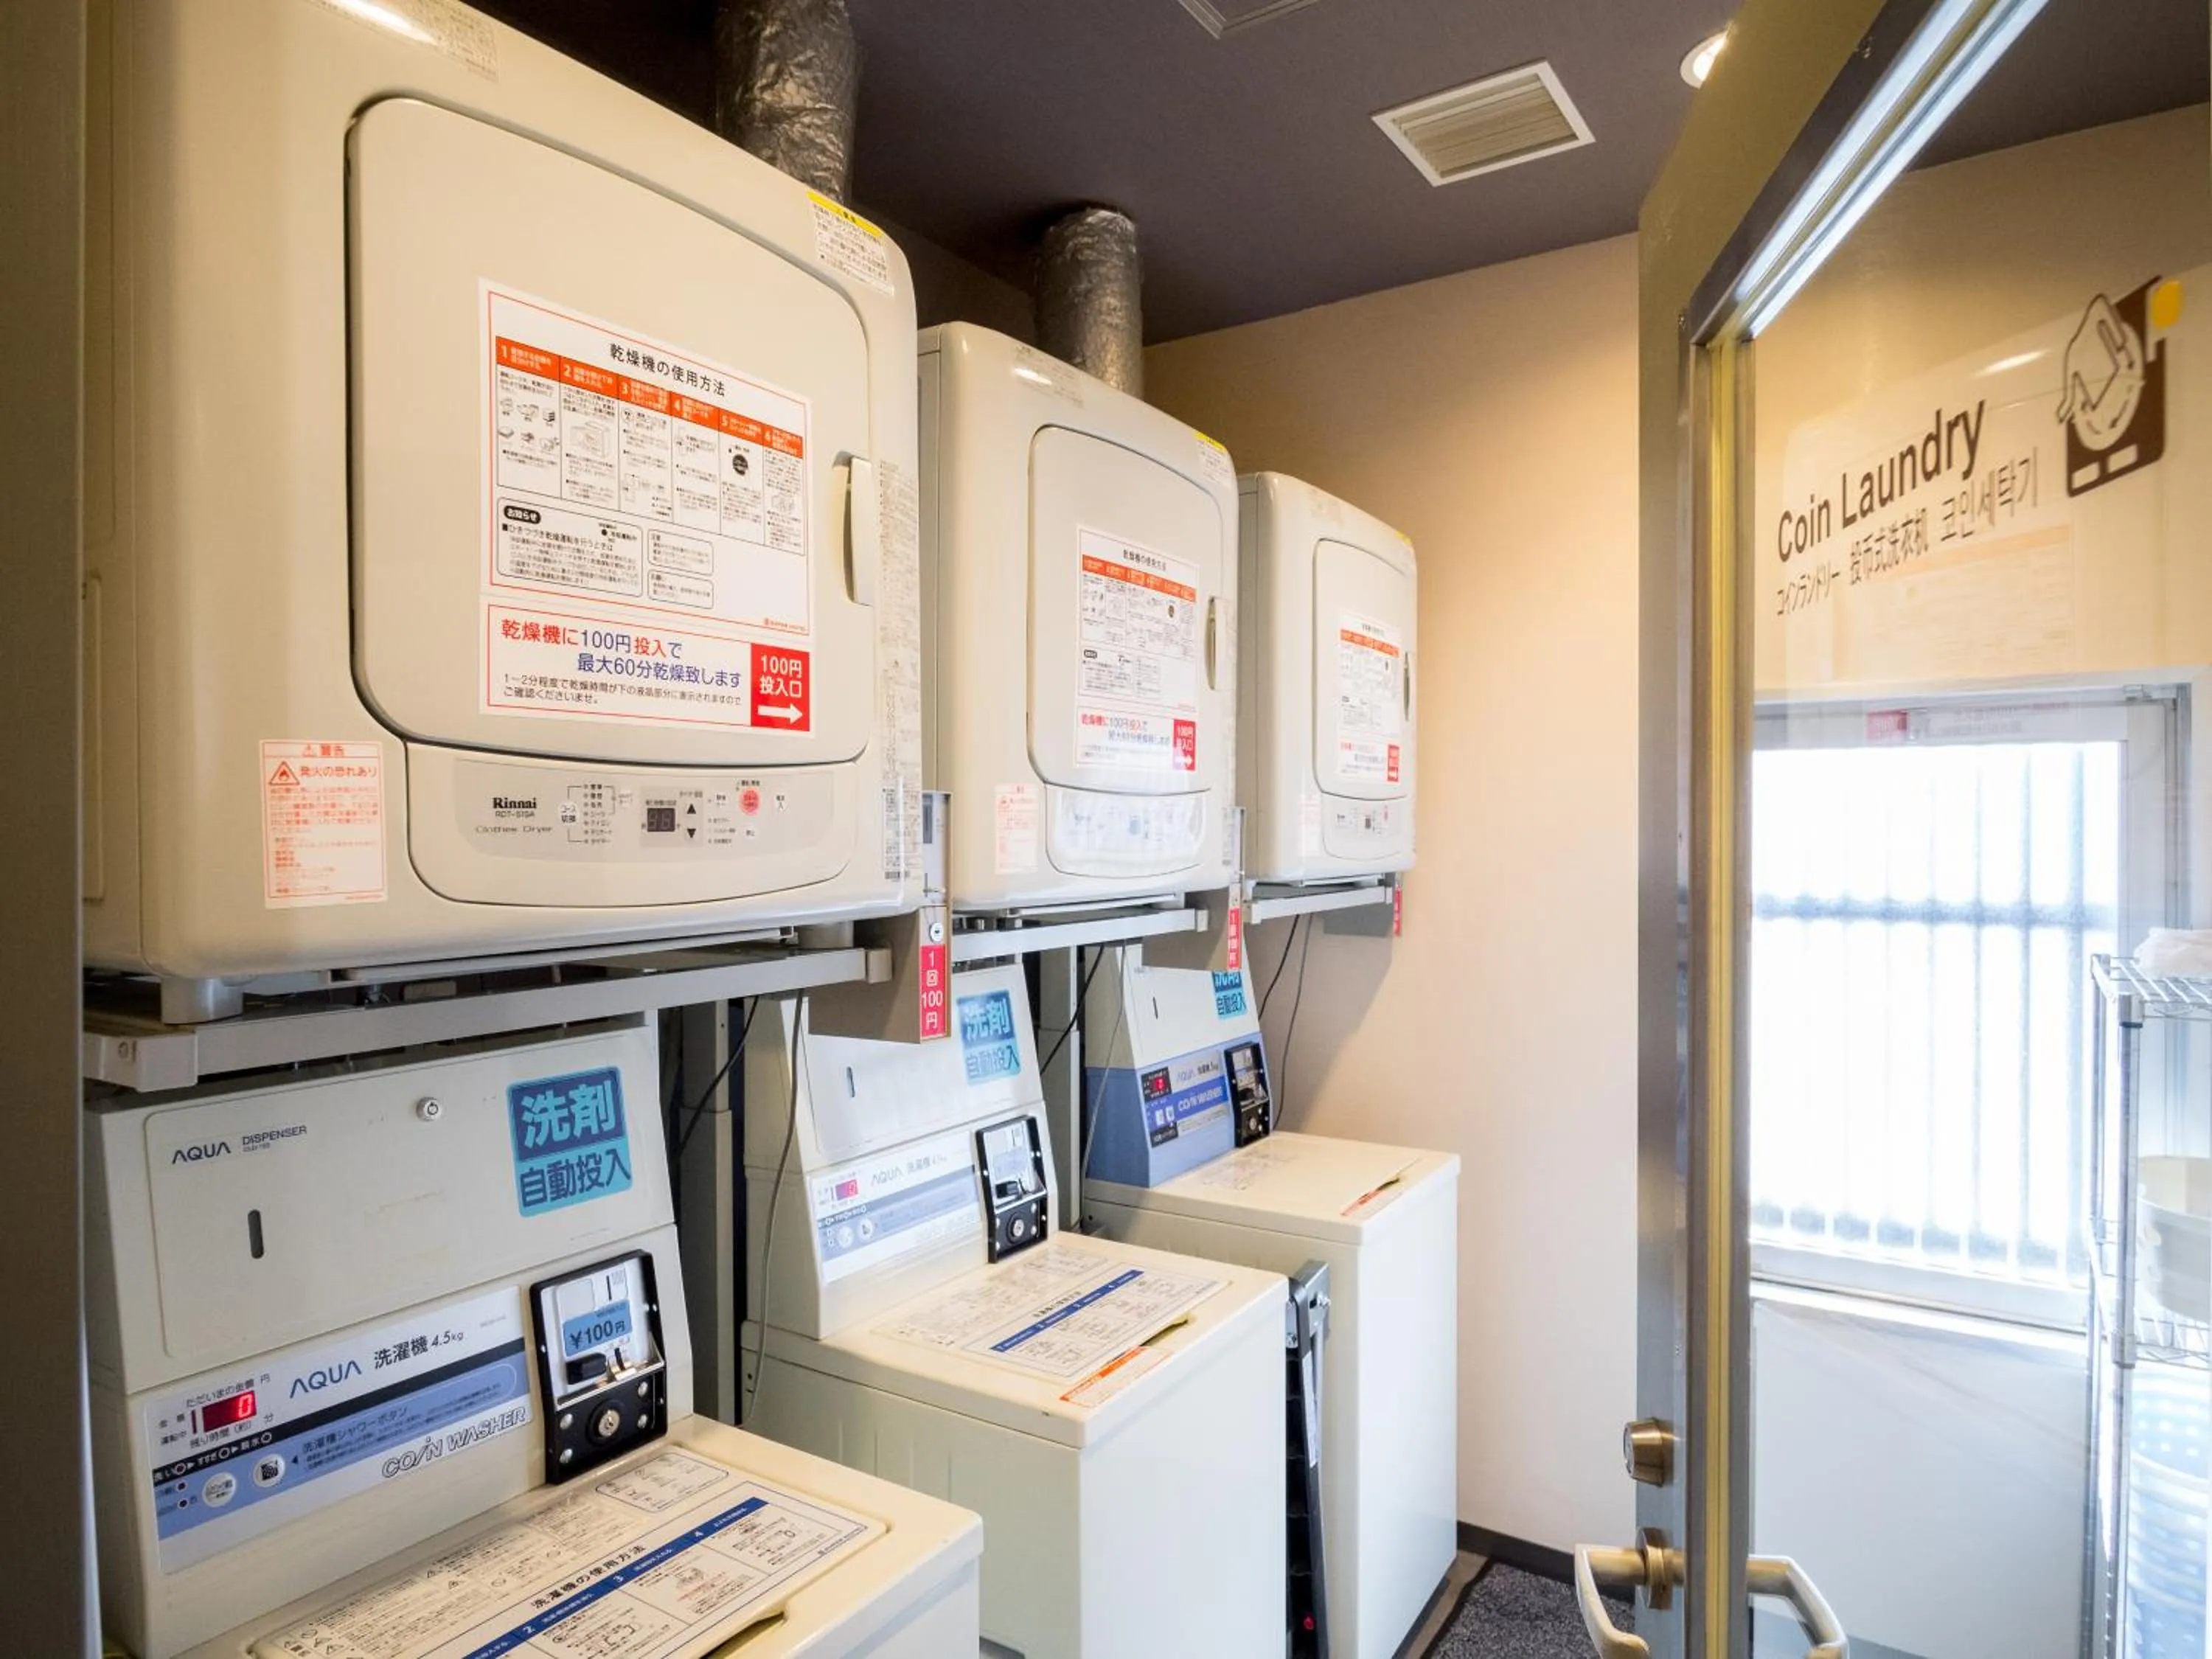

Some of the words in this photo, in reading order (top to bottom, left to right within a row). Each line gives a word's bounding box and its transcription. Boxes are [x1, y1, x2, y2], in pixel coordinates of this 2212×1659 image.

[501, 345, 507, 359] 1
[564, 365, 571, 378] 2
[609, 342, 726, 397] 乾燥機の使用方法
[622, 382, 627, 394] 3
[674, 400, 681, 411] 4
[721, 415, 728, 427] 5
[1778, 493, 1831, 563] Coin
[1842, 400, 1985, 528] Laundry
[1941, 447, 2039, 541] 코인세탁기
[501, 619, 682, 660] 乾燥機に100円投入で
[577, 653, 741, 687] 最大60分乾燥致します
[760, 655, 802, 676] 100円
[759, 676, 802, 698] 投入口
[493, 797, 537, 809] Rinnai
[964, 998, 1011, 1040] 洗剤
[967, 1046, 1020, 1077] 自動投入
[521, 1079, 617, 1148] 洗剤
[172, 1142, 231, 1164] AQUA
[242, 1124, 307, 1146] DISPENSER
[519, 1154, 630, 1208] 自動投入
[570, 1321, 625, 1349] ¥100円
[289, 1360, 362, 1398] AQUA
[374, 1335, 429, 1369] 洗濯機
[431, 1330, 465, 1348] 4.5kg
[239, 1394, 253, 1417] 0
[448, 1405, 526, 1452] WASHER
